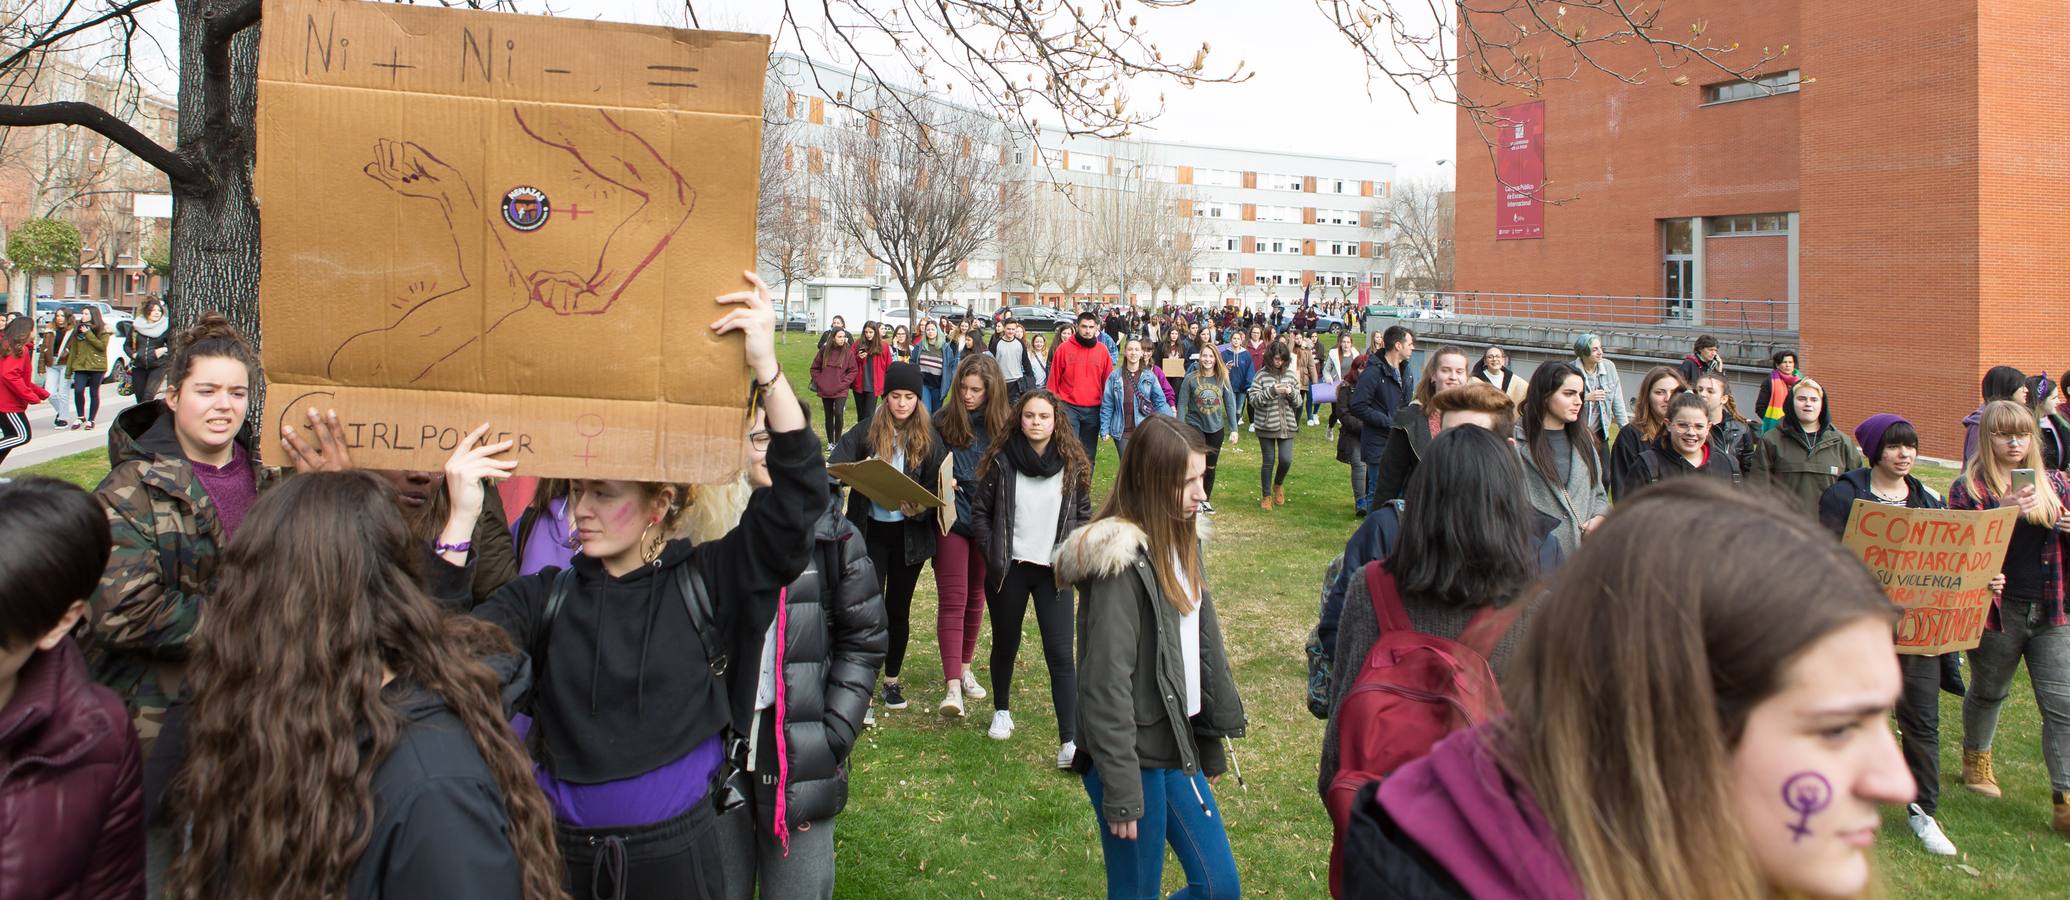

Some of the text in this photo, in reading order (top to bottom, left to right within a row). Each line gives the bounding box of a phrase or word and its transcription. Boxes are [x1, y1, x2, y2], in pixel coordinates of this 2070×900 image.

[304, 11, 349, 75] Ni
[462, 26, 514, 82] Ni
[508, 187, 545, 201] NENAZAS
[1984, 519, 2003, 545] EL
[1863, 545, 1992, 573] PATRIARCADO
[1897, 574, 1962, 590] VIOLENCIA
